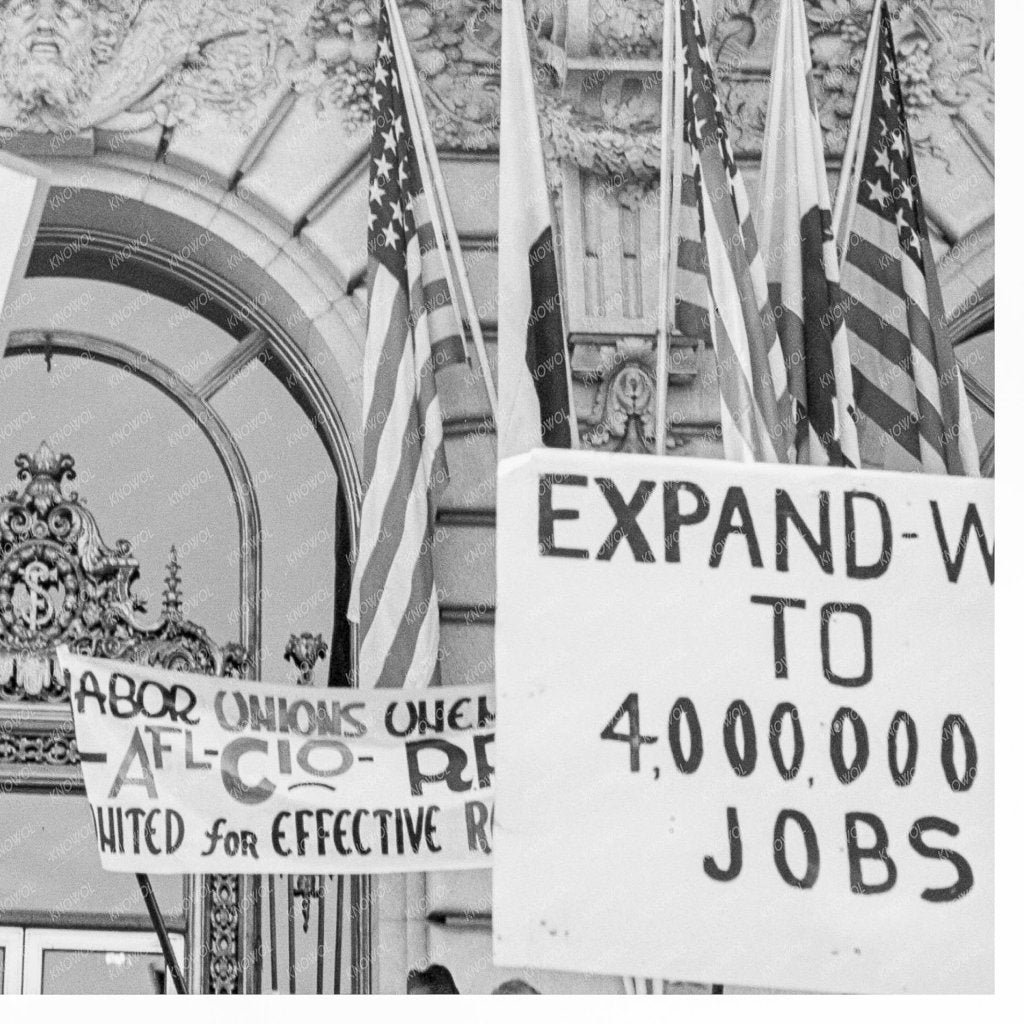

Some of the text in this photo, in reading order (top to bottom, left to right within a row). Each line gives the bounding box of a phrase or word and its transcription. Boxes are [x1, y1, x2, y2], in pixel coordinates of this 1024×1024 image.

[750, 595, 873, 688] TO
[213, 690, 369, 738] UNIONS
[270, 808, 443, 857] EFFECTIVE
[703, 807, 975, 903] JOBS
